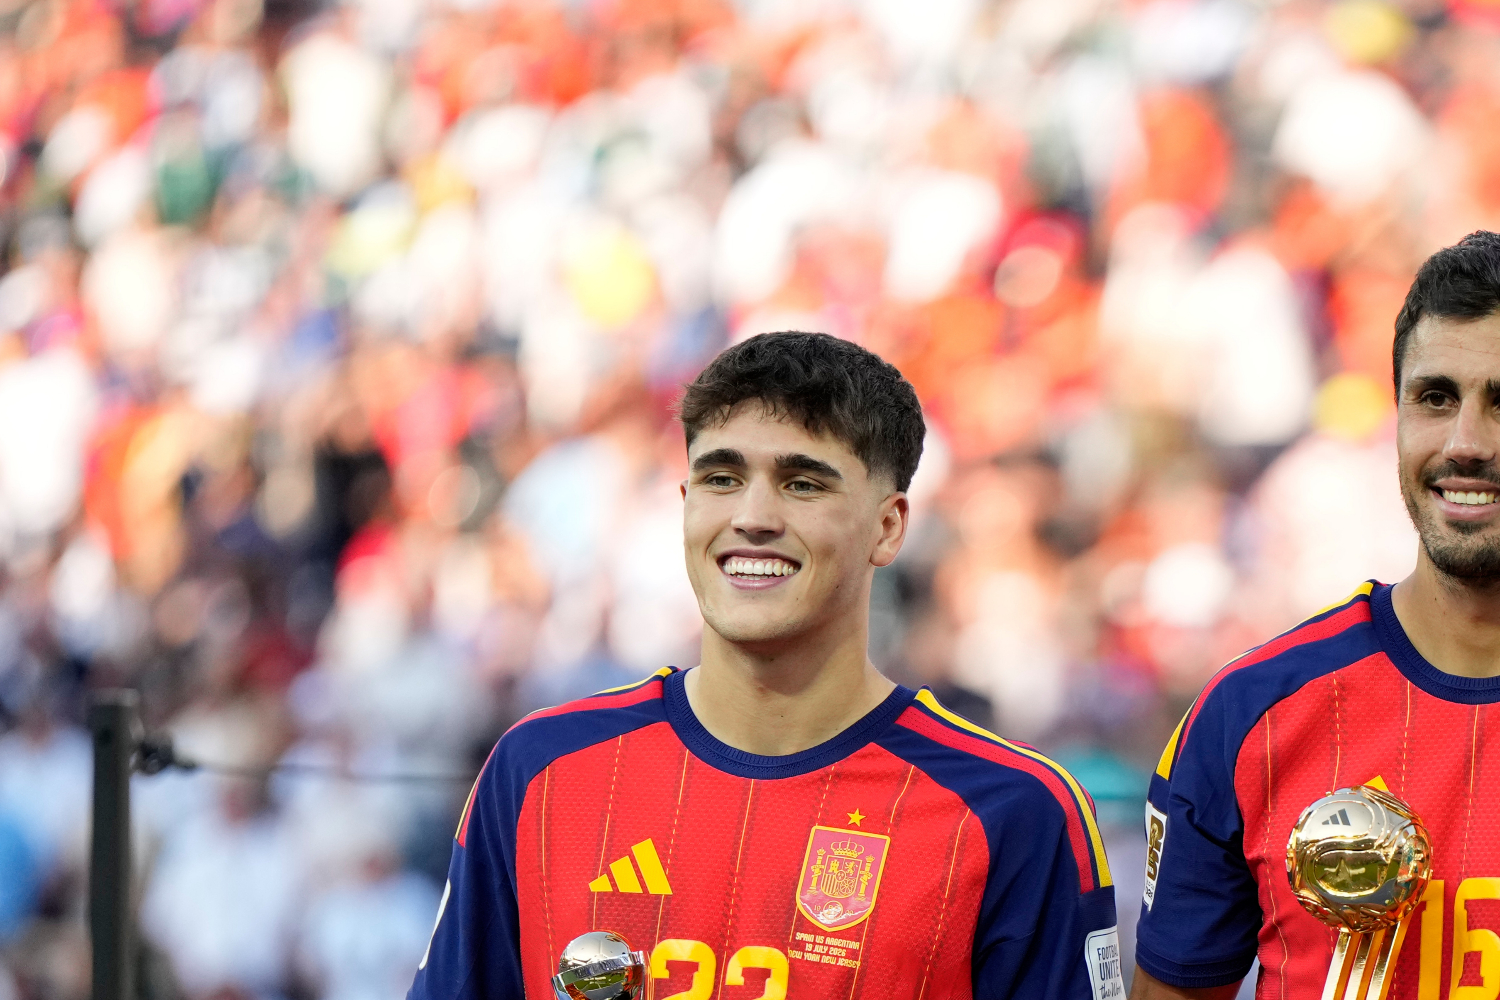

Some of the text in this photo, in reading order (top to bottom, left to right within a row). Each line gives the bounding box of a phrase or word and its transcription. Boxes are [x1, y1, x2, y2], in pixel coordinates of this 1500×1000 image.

[795, 932, 815, 942] SPAIN
[825, 937, 860, 950] ARGENTINA
[806, 943, 846, 957] 19 JULY 2026
[788, 949, 860, 968] NEW YORK NEW JERSEY
[1099, 959, 1120, 981] UNITE
